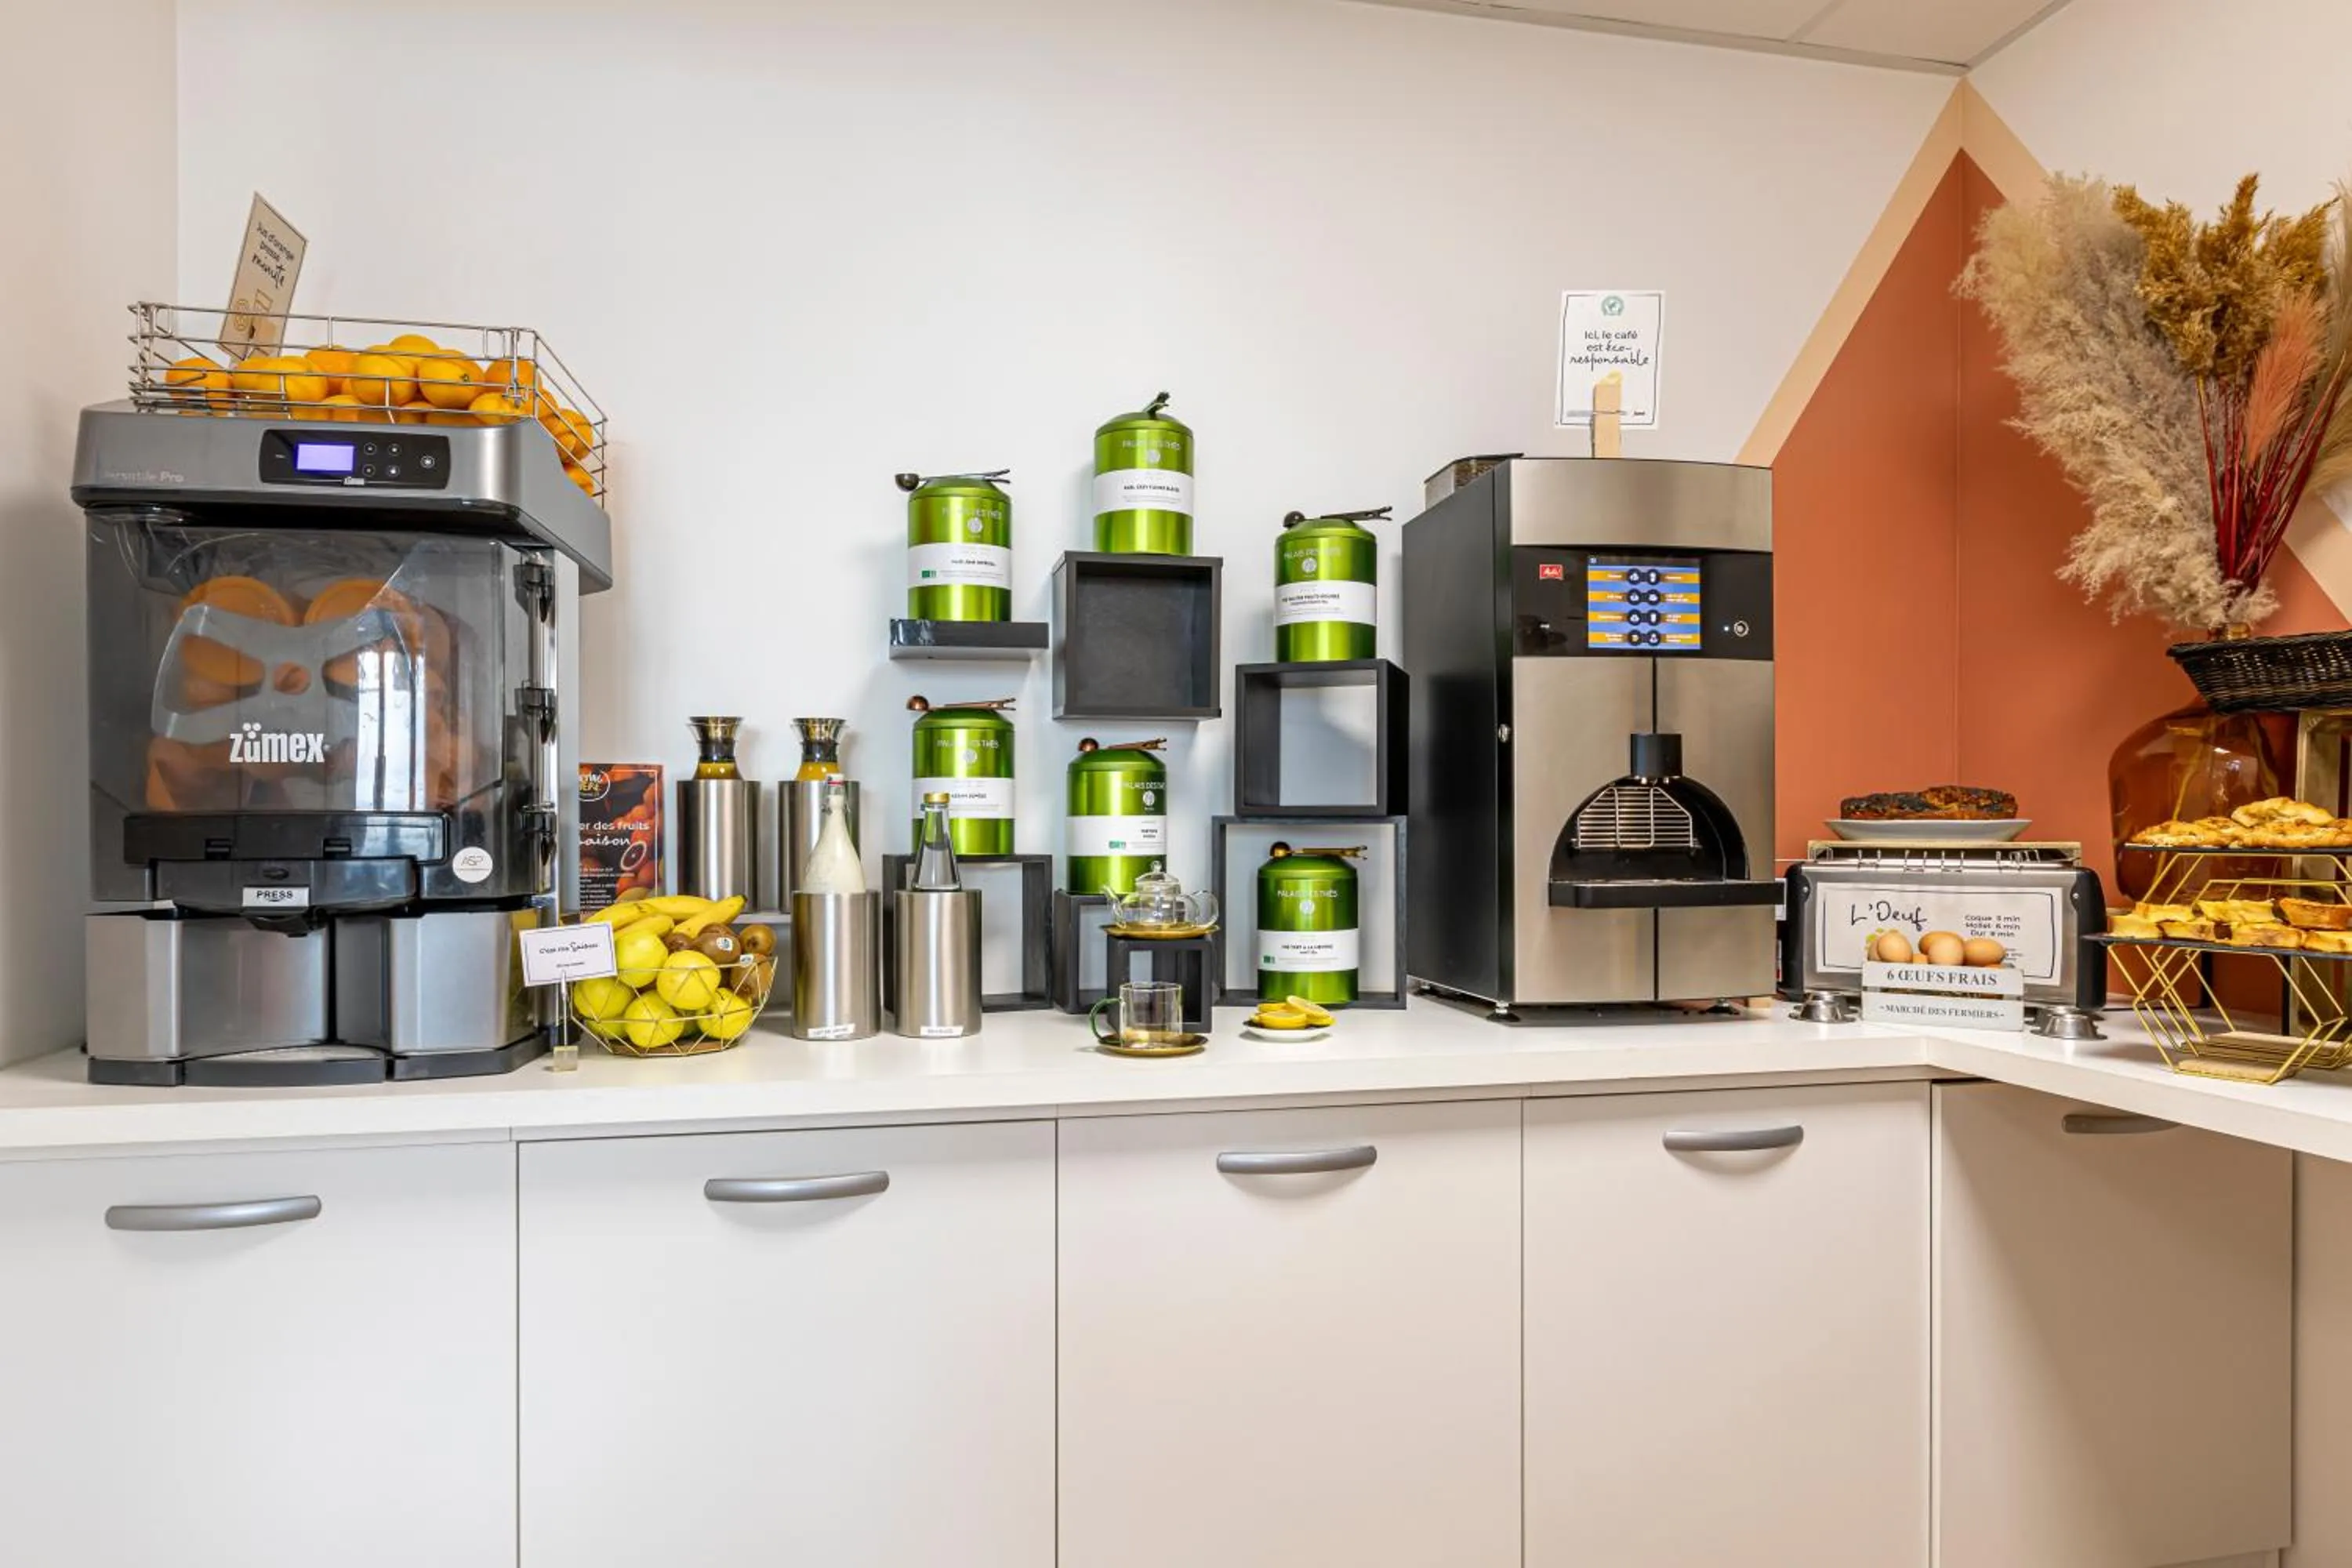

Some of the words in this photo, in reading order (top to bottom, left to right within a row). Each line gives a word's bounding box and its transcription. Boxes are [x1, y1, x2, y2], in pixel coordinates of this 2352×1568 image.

[1614, 331, 1638, 339] café
[1570, 350, 1649, 372] responsable
[160, 471, 184, 482] Pro
[593, 821, 615, 830] des
[618, 821, 650, 830] fruits
[579, 833, 630, 846] aison
[256, 890, 294, 899] PRESS
[1887, 971, 1895, 980] 6
[1948, 971, 1998, 985] FRAIS
[1928, 1007, 1947, 1015] DES
[1948, 1008, 1999, 1018] FERMIERS
